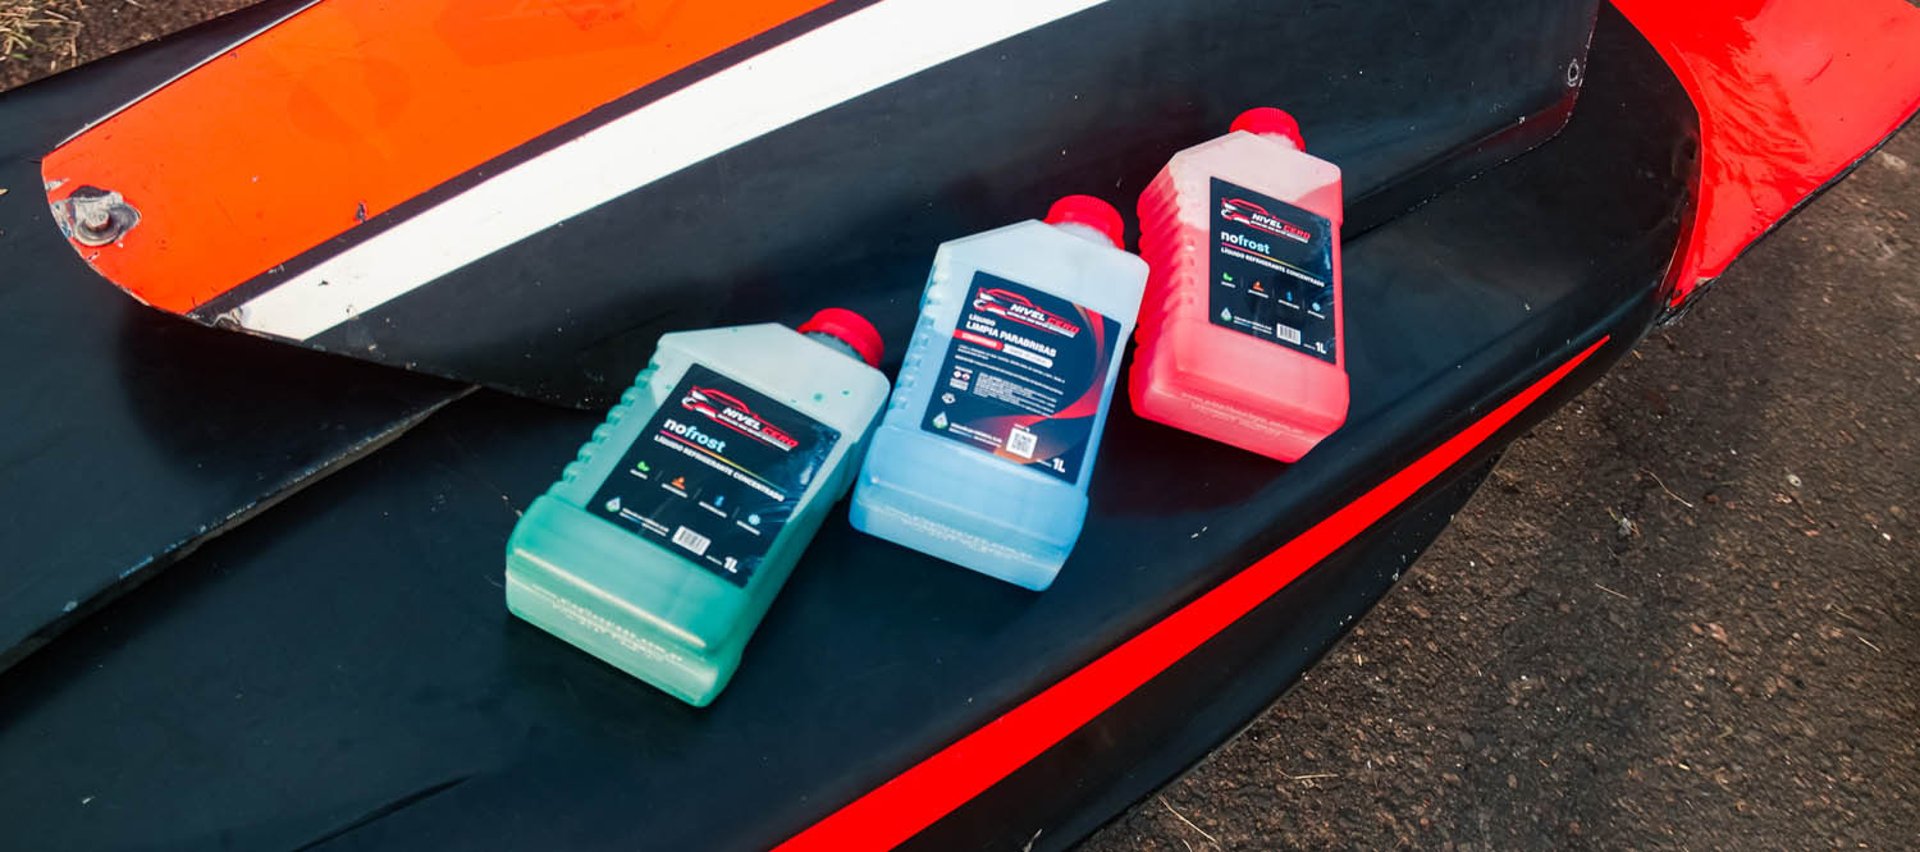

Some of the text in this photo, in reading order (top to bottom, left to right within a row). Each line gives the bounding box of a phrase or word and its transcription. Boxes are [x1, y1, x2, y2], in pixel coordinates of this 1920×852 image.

[1252, 213, 1282, 229] NIVEL
[1283, 224, 1311, 240] CERO
[1220, 231, 1270, 254] nofrost
[1010, 303, 1045, 322] NIVEL
[966, 320, 999, 338] LIMPIA
[999, 331, 1057, 358] PARABRISAS
[1315, 342, 1327, 354] 1L
[722, 407, 762, 431] NIVEL
[663, 418, 726, 453] nofrost
[1052, 457, 1066, 473] 1L
[723, 556, 738, 574] 1L
